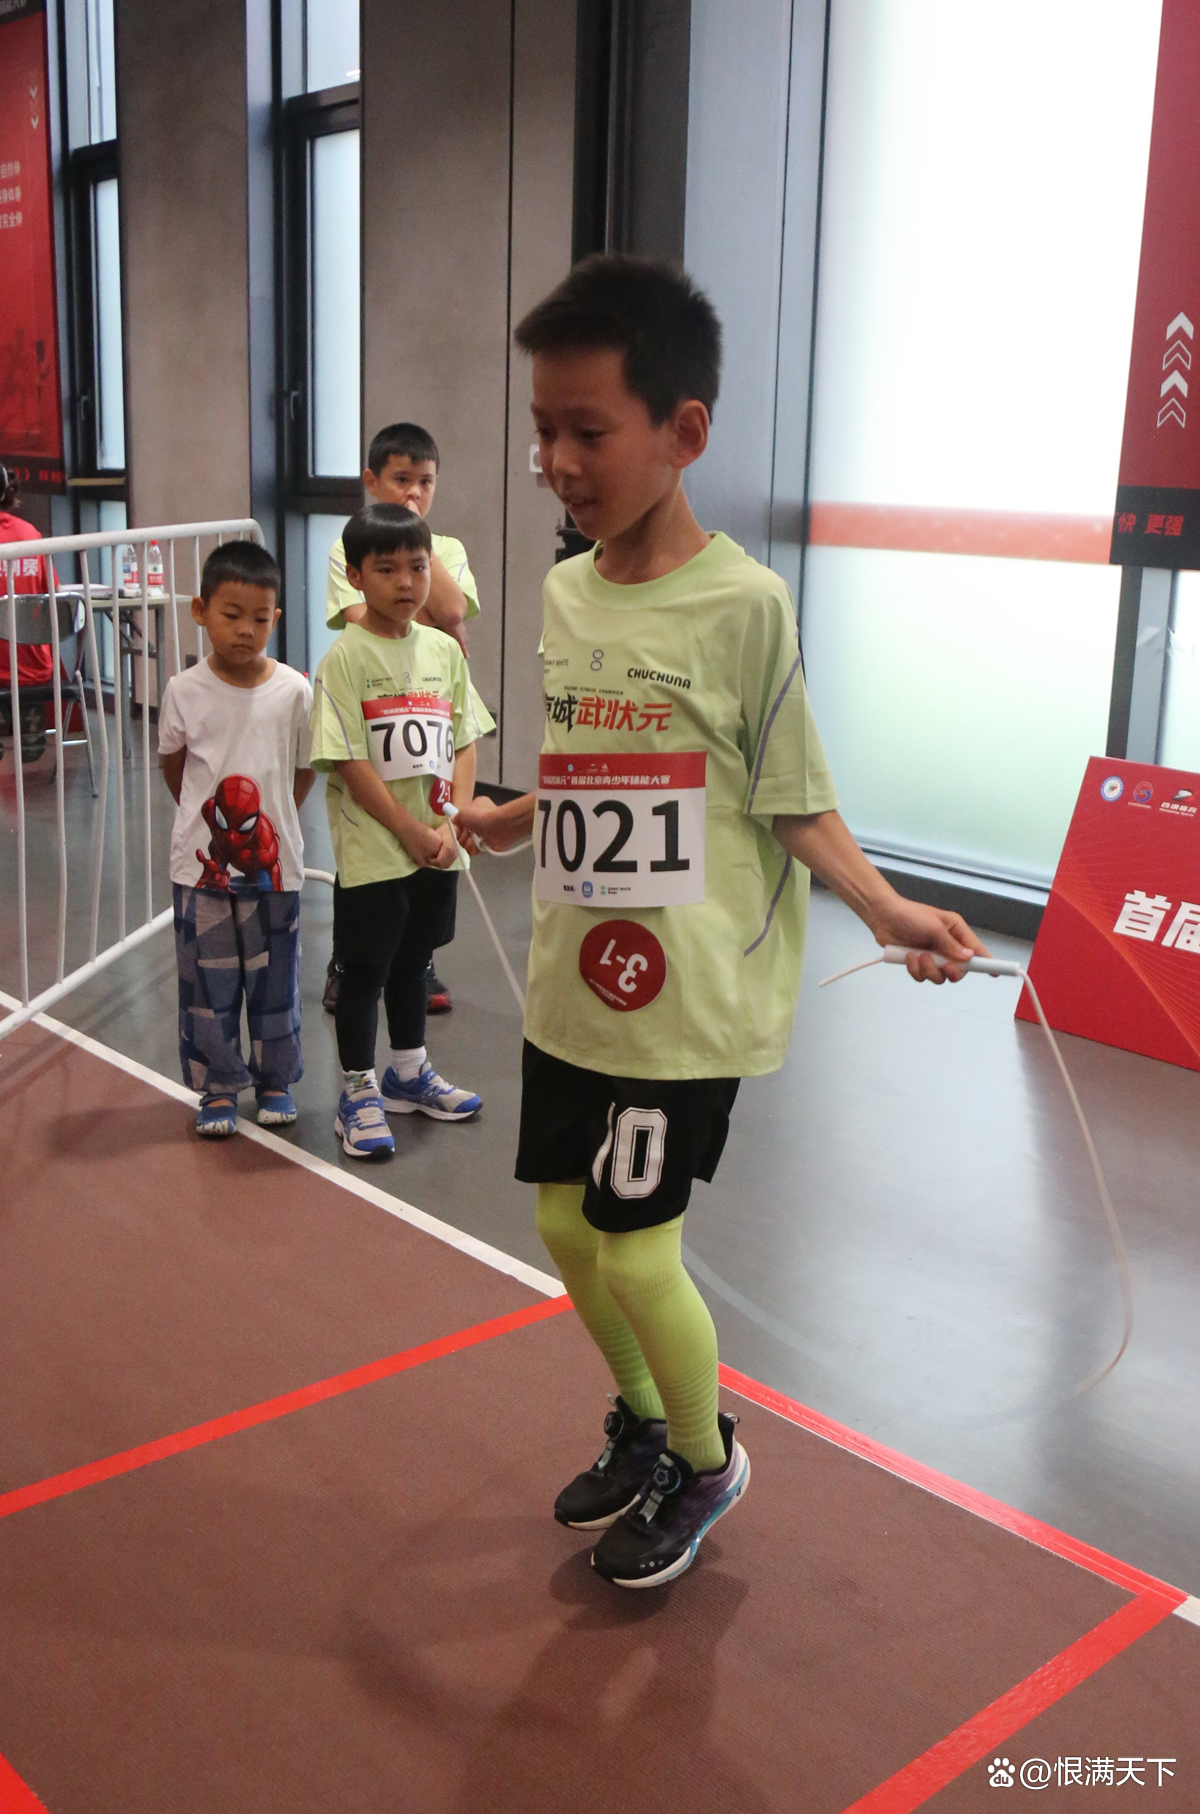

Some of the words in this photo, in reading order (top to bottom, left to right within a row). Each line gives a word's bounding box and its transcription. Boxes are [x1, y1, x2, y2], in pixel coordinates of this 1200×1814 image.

[1115, 511, 1136, 533] 快
[1144, 514, 1184, 536] 更强
[0, 558, 39, 577] 判员
[627, 667, 692, 690] CHUCHUNA
[370, 719, 453, 763] 7076
[538, 799, 690, 873] 7021
[1113, 889, 1200, 954] 首届
